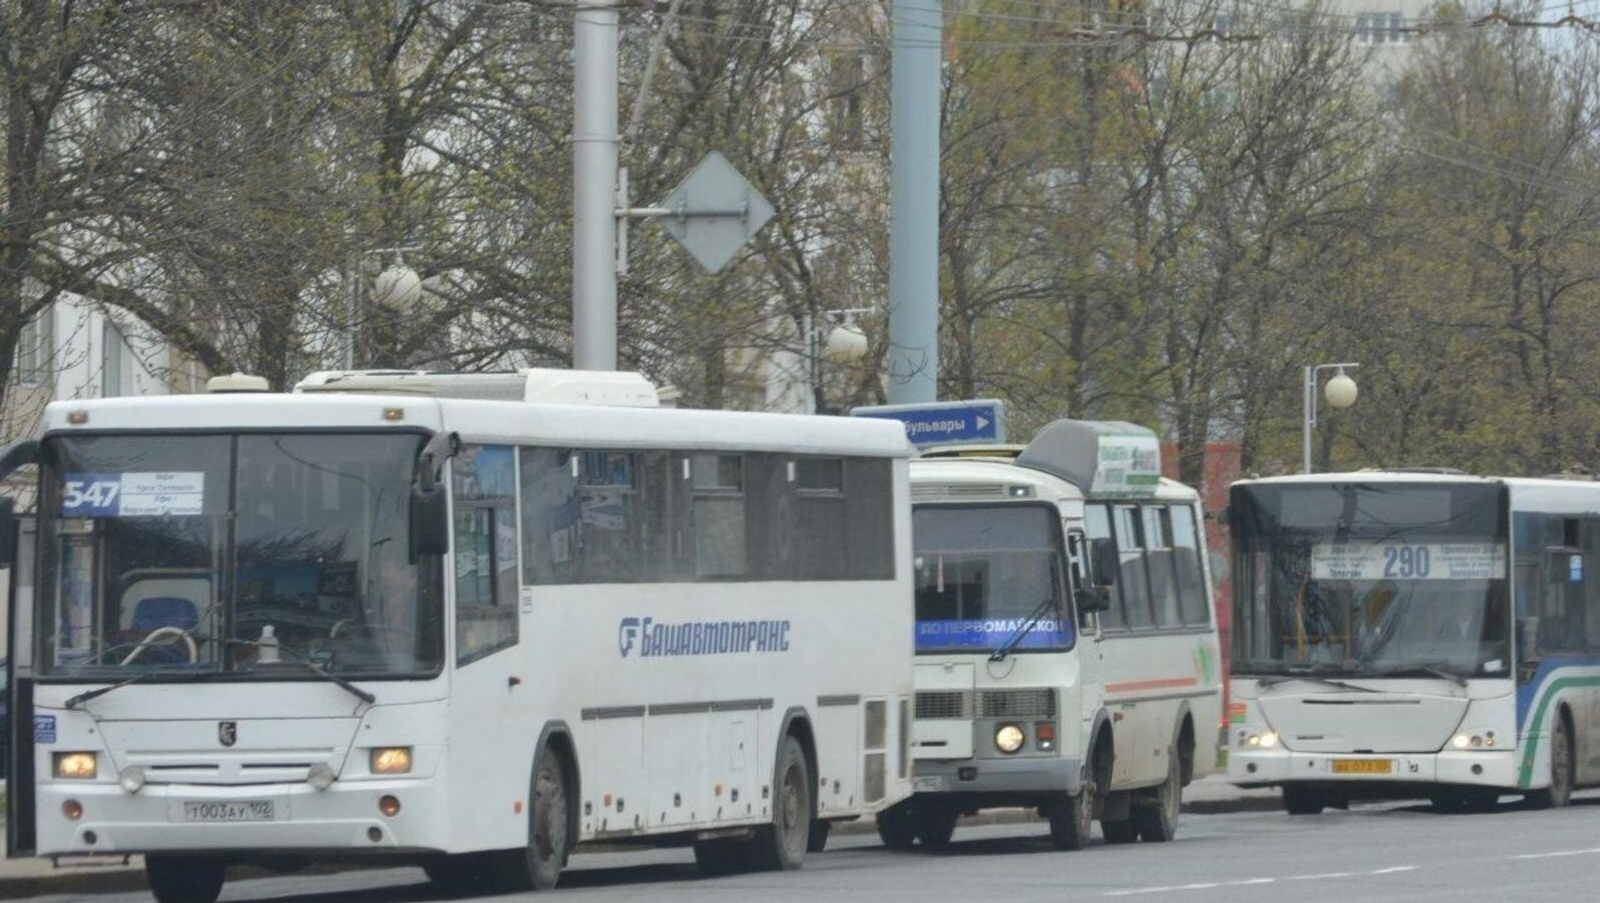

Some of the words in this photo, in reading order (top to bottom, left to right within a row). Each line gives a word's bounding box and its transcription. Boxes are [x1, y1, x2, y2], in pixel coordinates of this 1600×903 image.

[905, 420, 965, 436] бульвары
[63, 481, 120, 508] 547
[1383, 545, 1430, 578] 290
